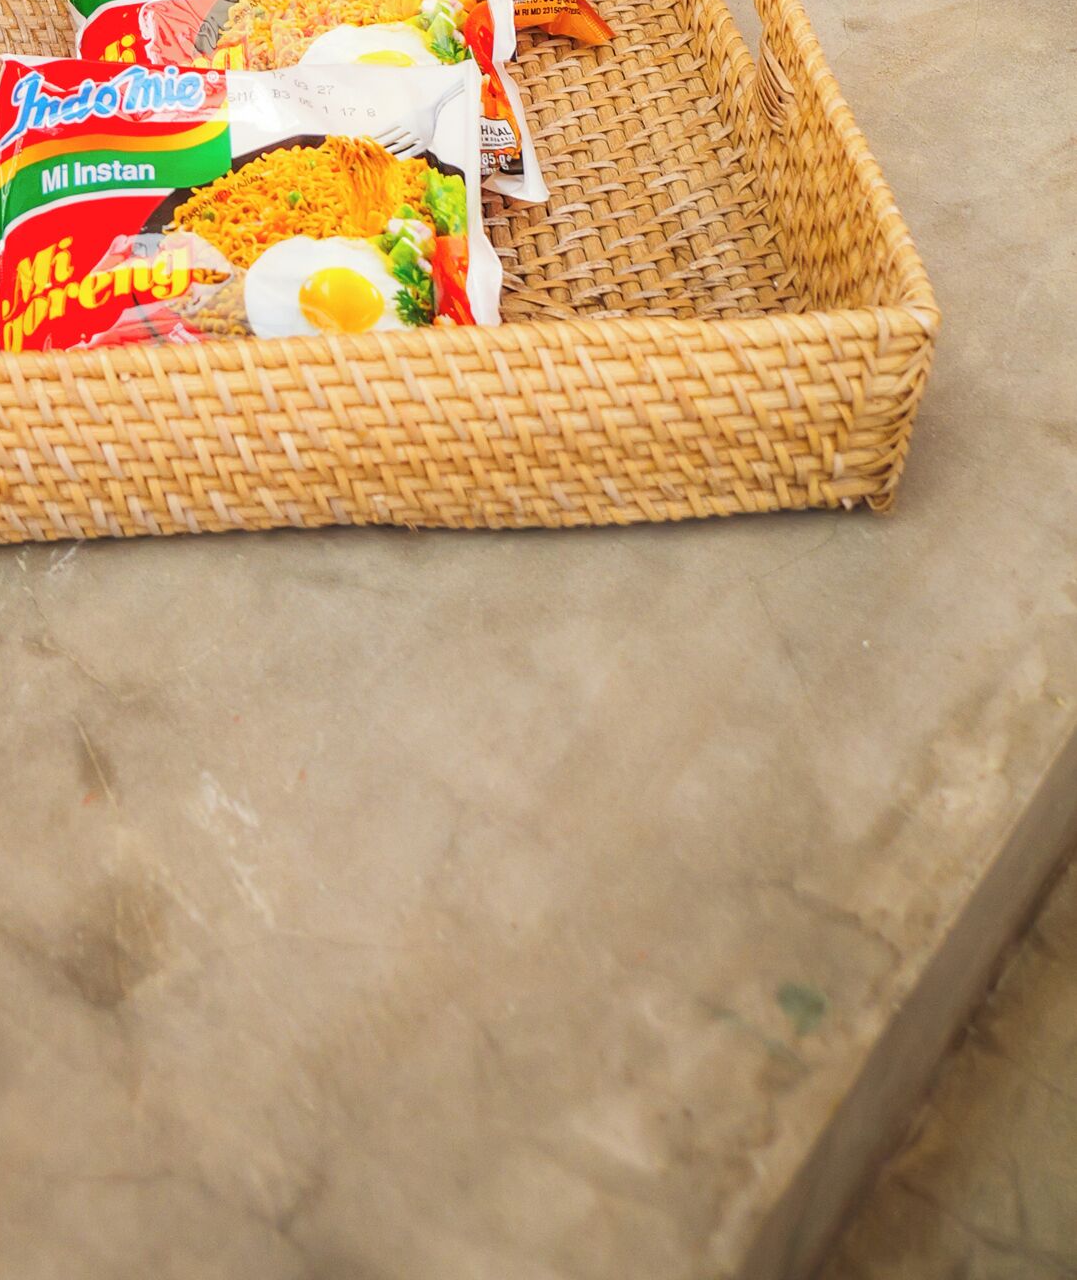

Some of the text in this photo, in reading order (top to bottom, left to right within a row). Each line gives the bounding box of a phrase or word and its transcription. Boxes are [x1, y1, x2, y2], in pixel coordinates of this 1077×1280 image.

[41, 160, 156, 195] Mi Instan
[481, 152, 496, 166] 85
[1, 236, 75, 320] Mi
[3, 248, 194, 352] goreng
